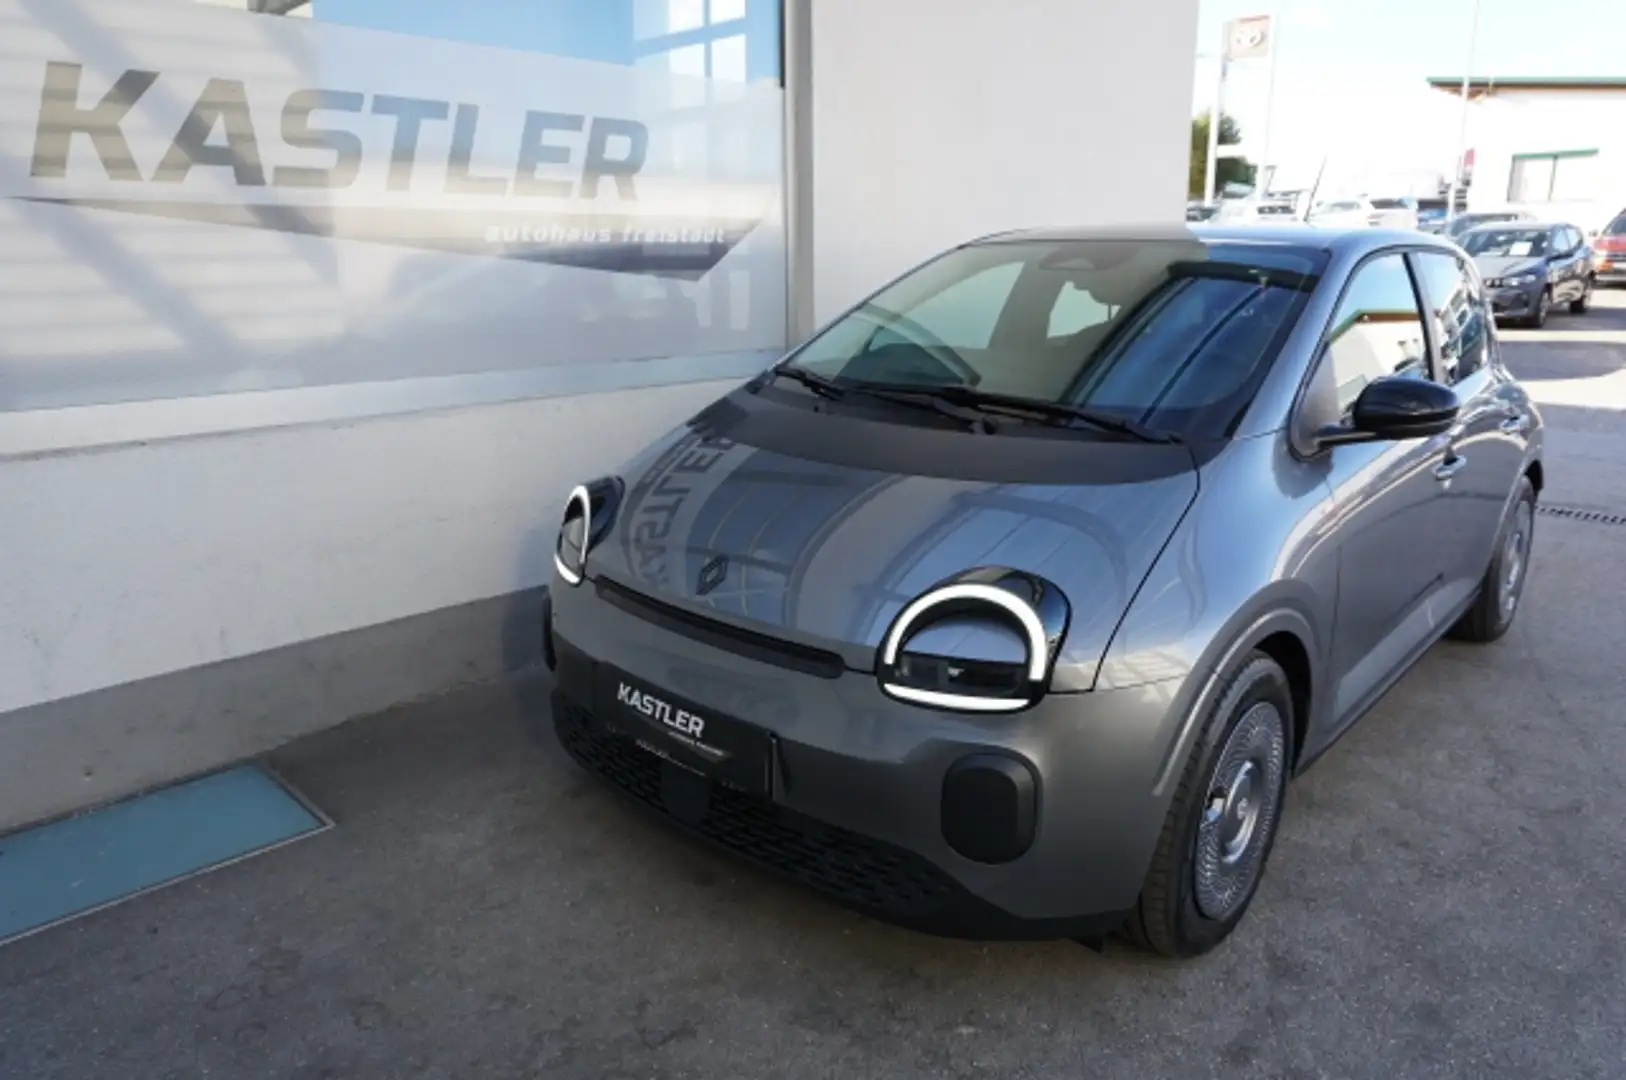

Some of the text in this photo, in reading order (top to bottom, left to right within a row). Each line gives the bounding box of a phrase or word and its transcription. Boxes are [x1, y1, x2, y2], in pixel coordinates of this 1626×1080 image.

[30, 61, 649, 201] KASTLER
[484, 221, 612, 243] autohaus
[617, 682, 705, 738] KASTLER
